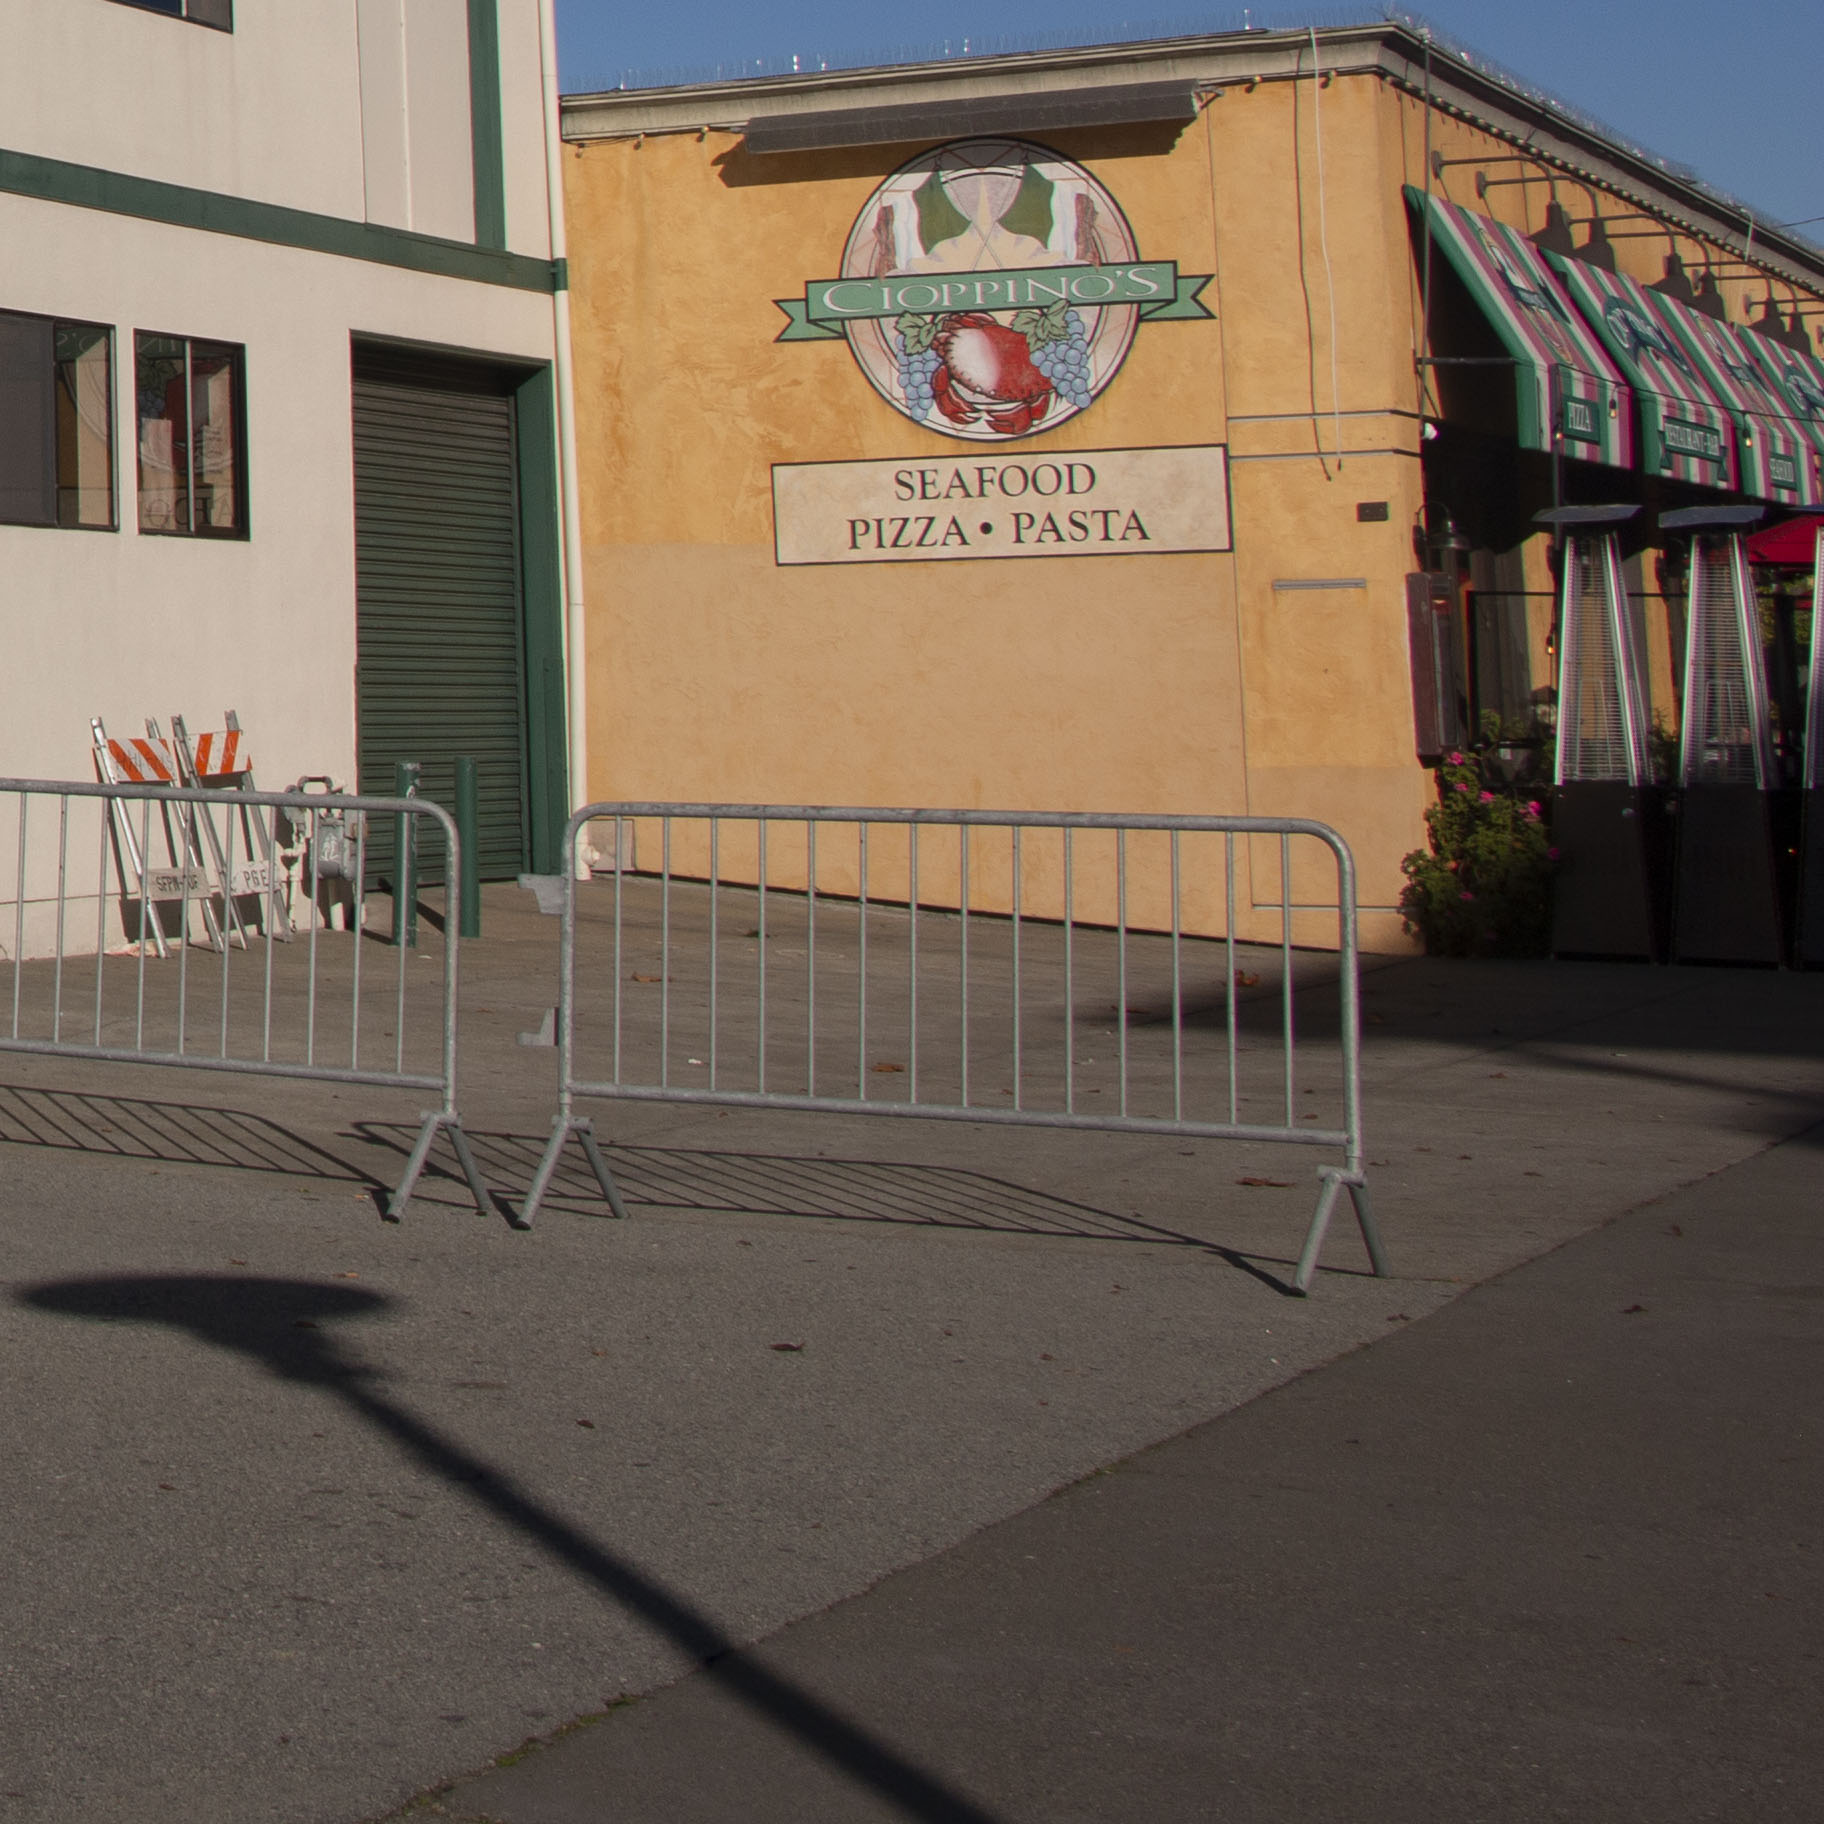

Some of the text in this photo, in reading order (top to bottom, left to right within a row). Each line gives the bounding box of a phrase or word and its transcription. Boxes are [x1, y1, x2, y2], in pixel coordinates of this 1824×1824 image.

[893, 462, 1097, 502] SEAFOOD
[846, 508, 1151, 551] PIZZA PASTA
